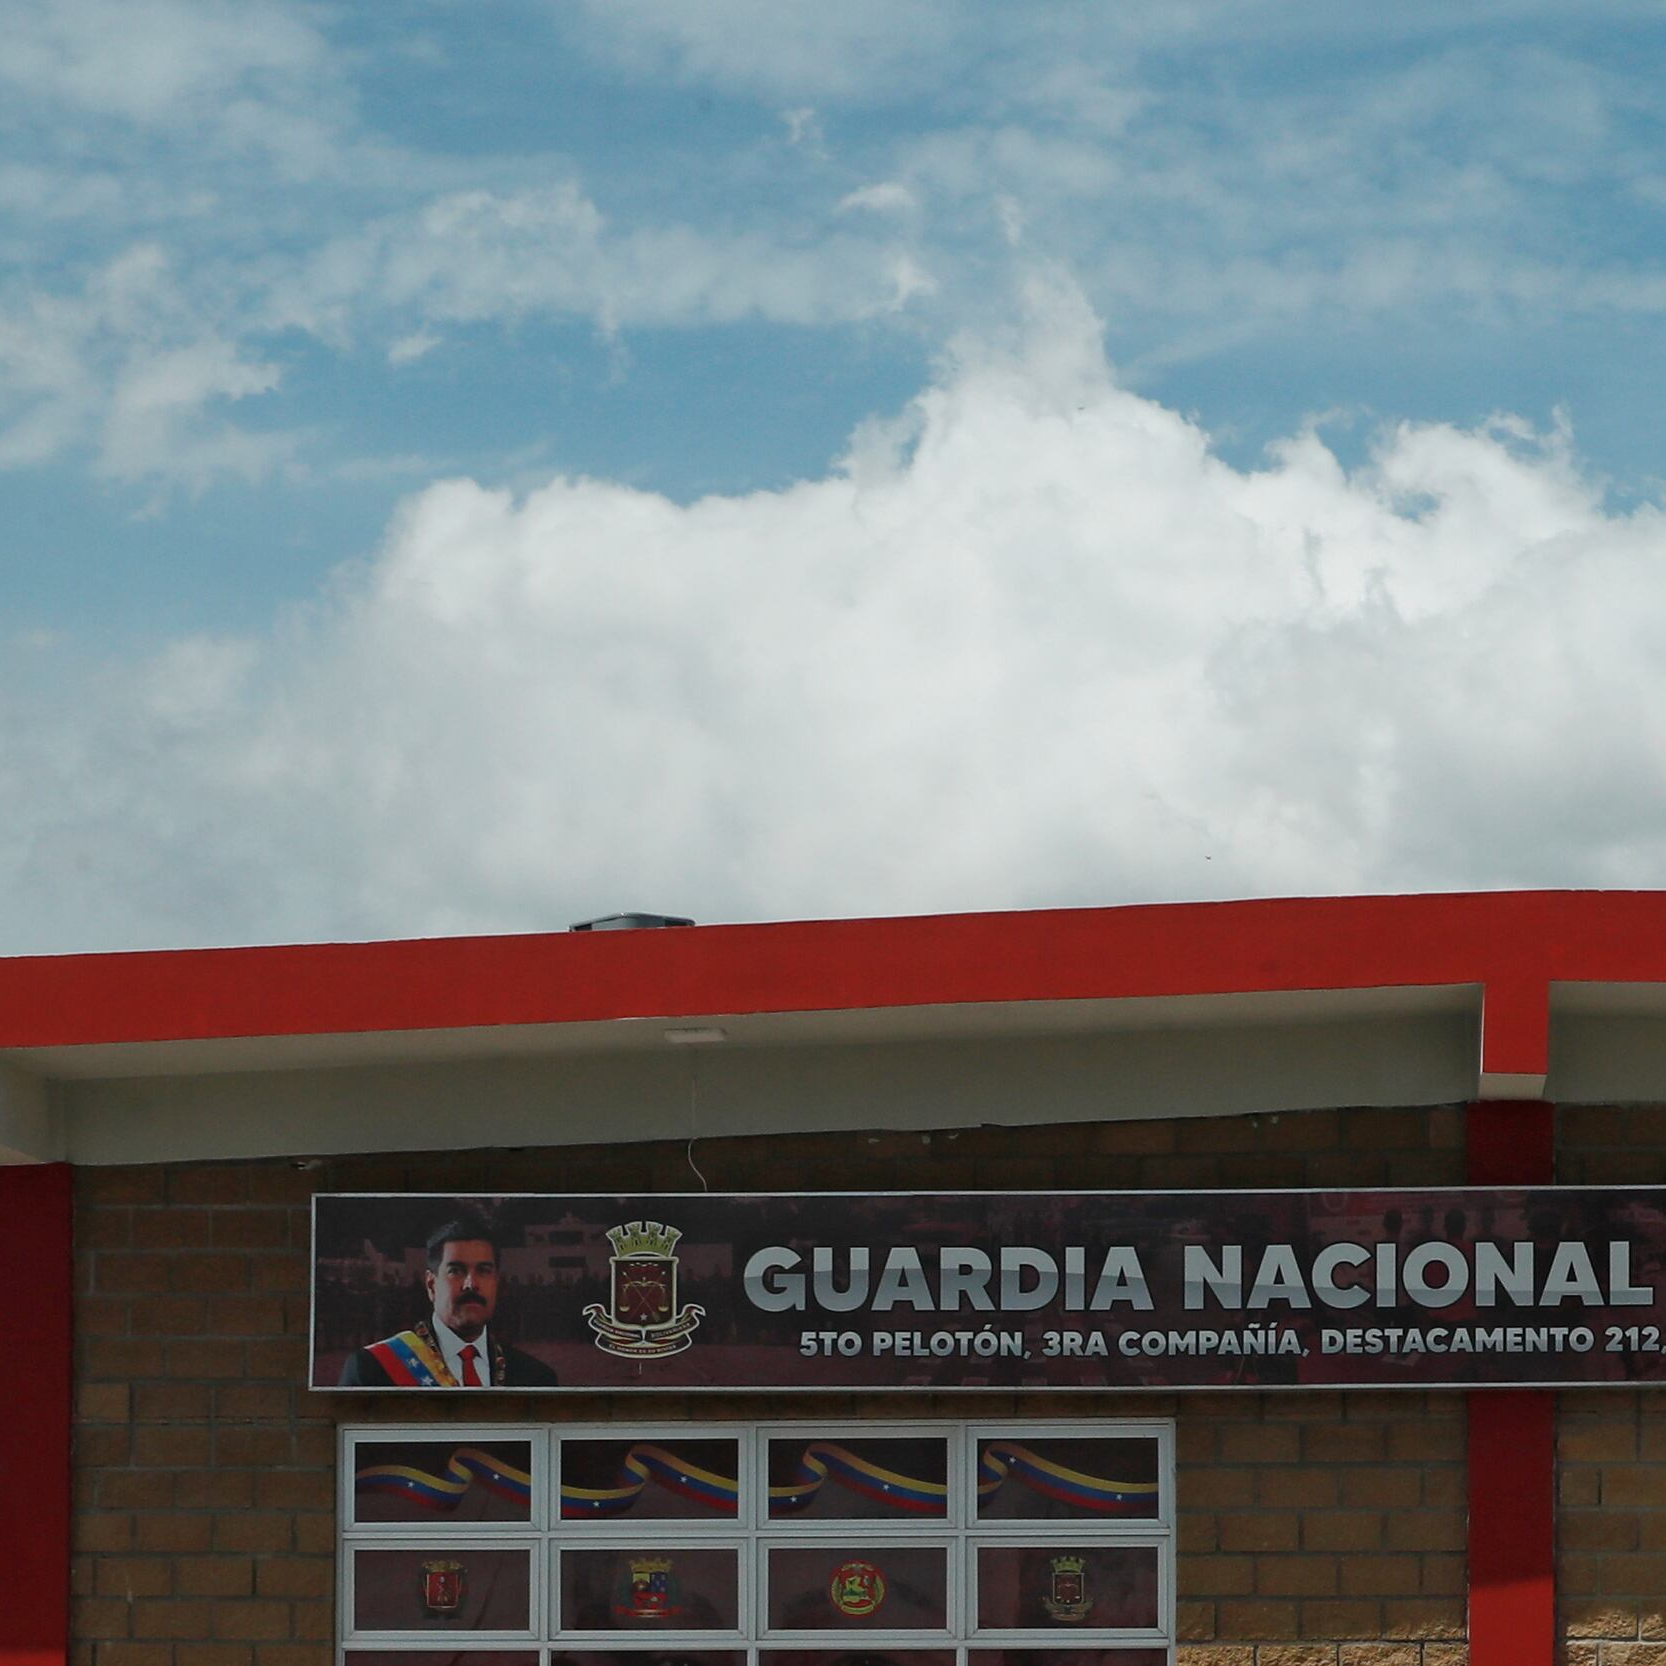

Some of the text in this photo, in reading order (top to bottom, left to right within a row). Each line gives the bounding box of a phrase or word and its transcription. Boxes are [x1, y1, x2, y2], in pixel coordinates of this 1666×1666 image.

[743, 1245, 1154, 1313] GUARDIA
[1184, 1240, 1654, 1311] NACIONAL
[799, 1331, 862, 1357] 5TO
[873, 1323, 1031, 1361] PELOTÓN,
[1042, 1330, 1109, 1357] 3RA
[1118, 1322, 1310, 1359] COMPAÑÍA,
[1321, 1326, 1594, 1355] DESTACAMENTO
